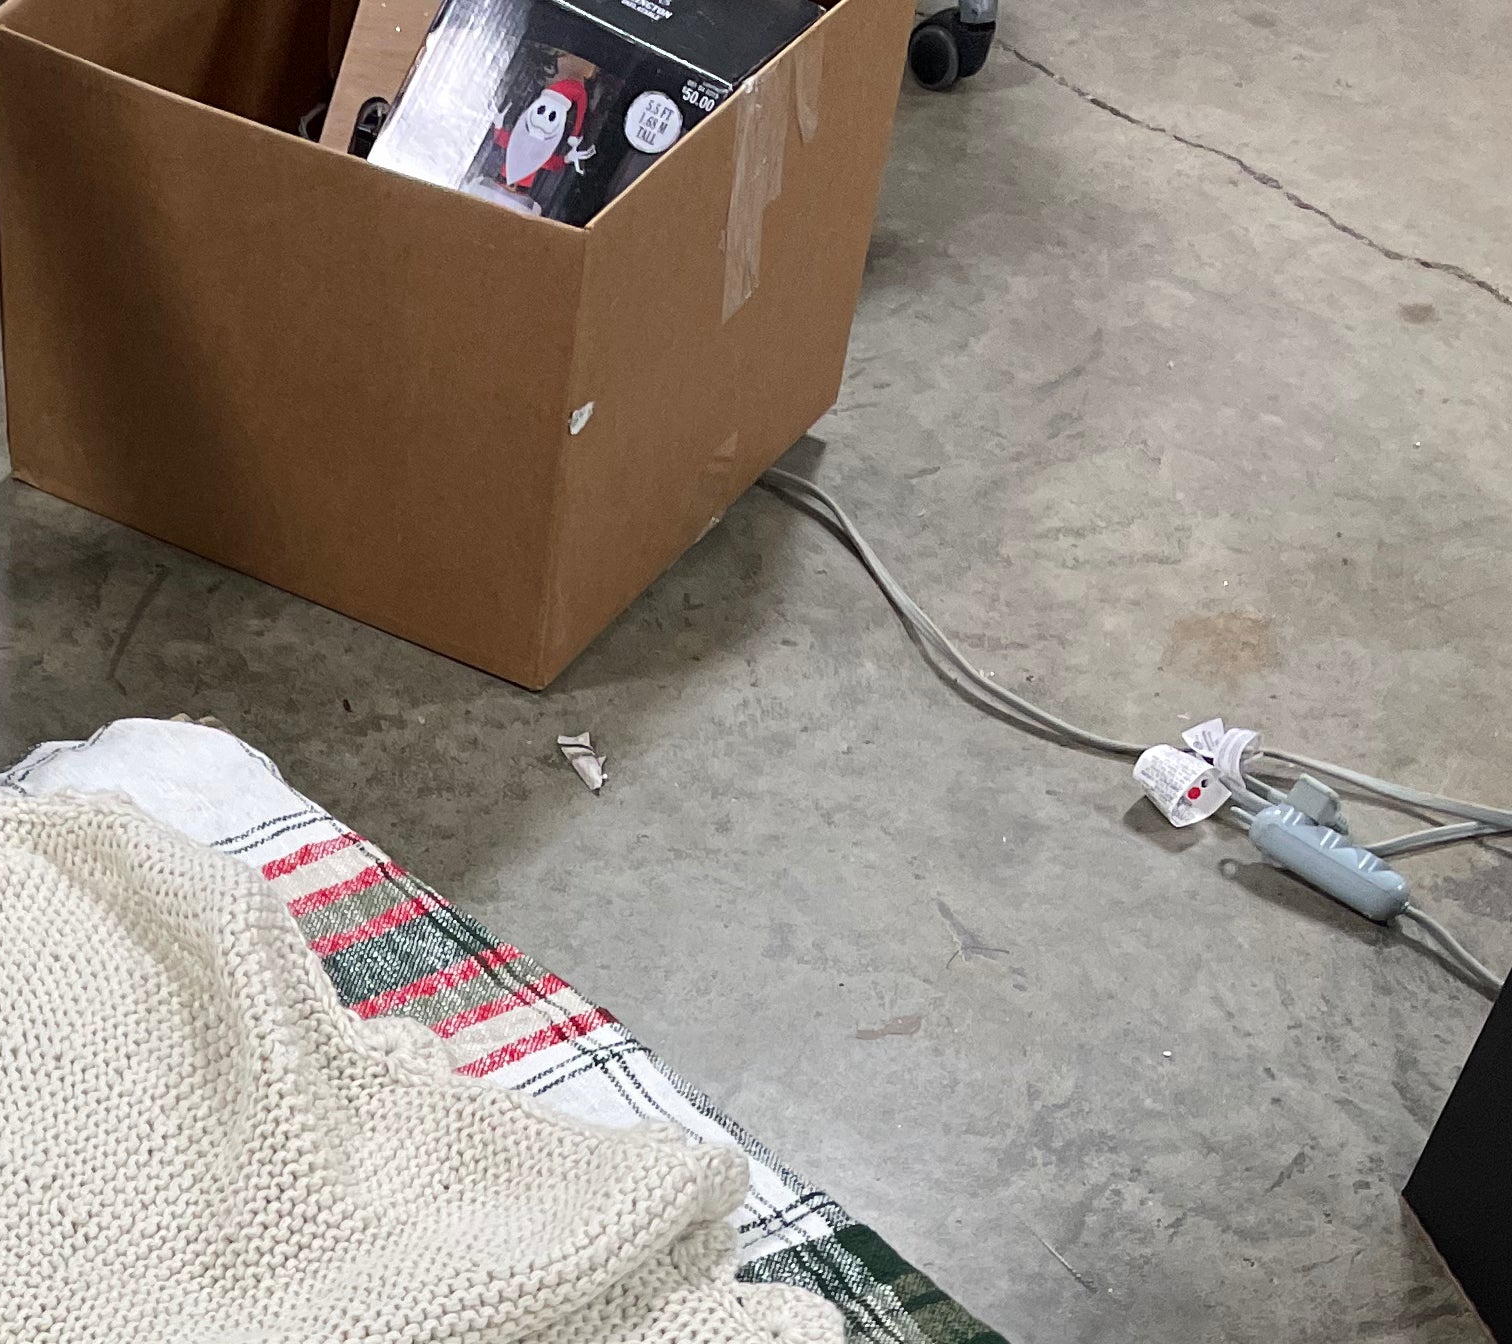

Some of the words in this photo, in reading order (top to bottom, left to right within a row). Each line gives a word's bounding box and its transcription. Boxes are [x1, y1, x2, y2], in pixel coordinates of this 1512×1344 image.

[659, 106, 674, 121] FT
[658, 121, 668, 135] M
[636, 126, 656, 146] TALL
